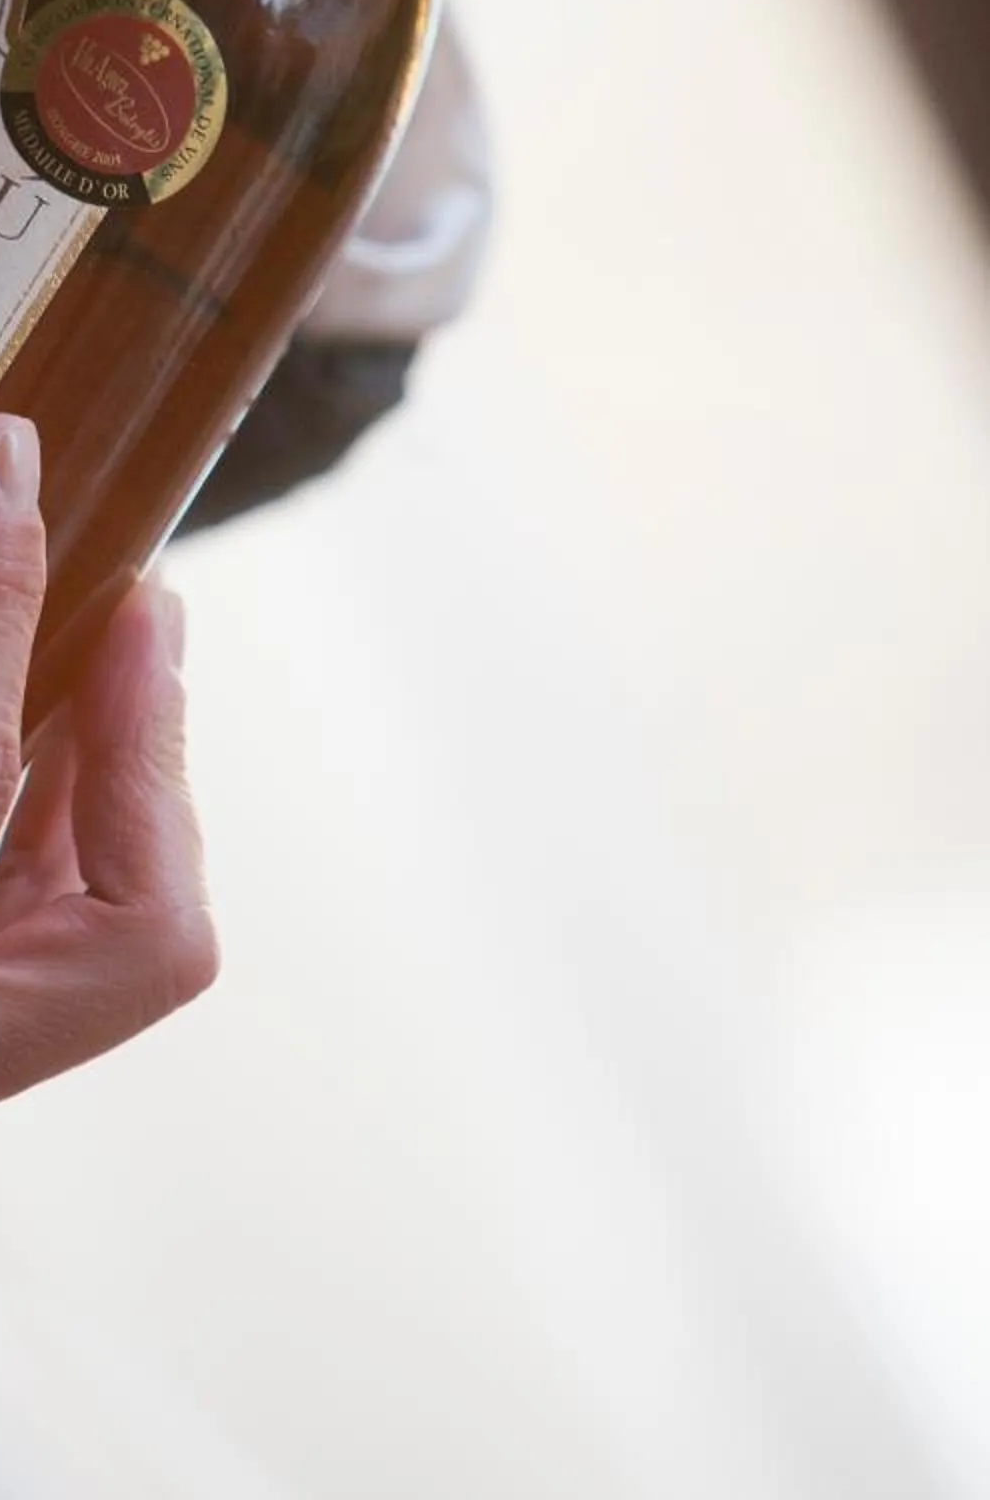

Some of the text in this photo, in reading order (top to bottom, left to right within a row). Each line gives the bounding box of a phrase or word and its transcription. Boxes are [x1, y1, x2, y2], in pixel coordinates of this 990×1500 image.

[193, 115, 212, 142] DE
[161, 145, 201, 182] VINS
[77, 175, 131, 200] D'OR
